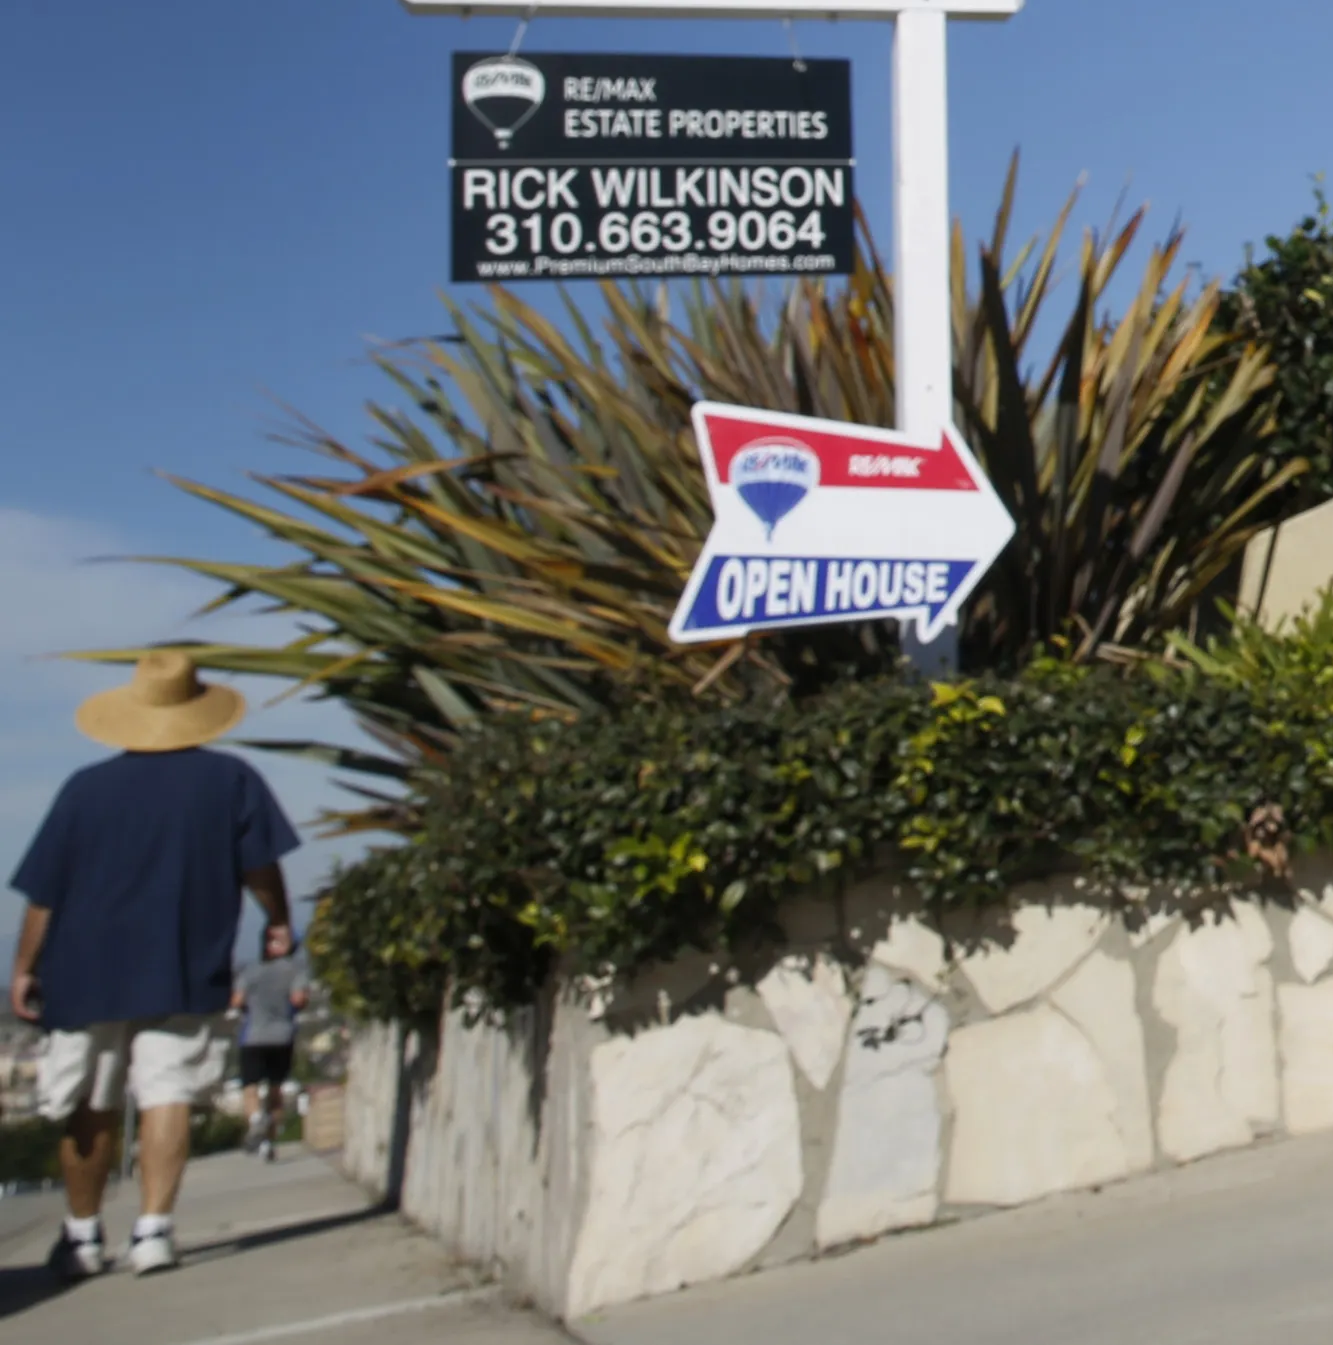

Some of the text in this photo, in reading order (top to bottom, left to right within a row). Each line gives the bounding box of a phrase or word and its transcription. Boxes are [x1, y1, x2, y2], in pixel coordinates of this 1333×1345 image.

[563, 77, 657, 102] RE/MAX
[564, 108, 828, 140] ESTATE PROPERTIES
[463, 167, 844, 209] RICK WILKINSON
[485, 210, 826, 255] 310.663.9064
[477, 253, 835, 277] www.PremiumSouthBayHomes.com
[716, 557, 950, 621] OPEN HOUSE
